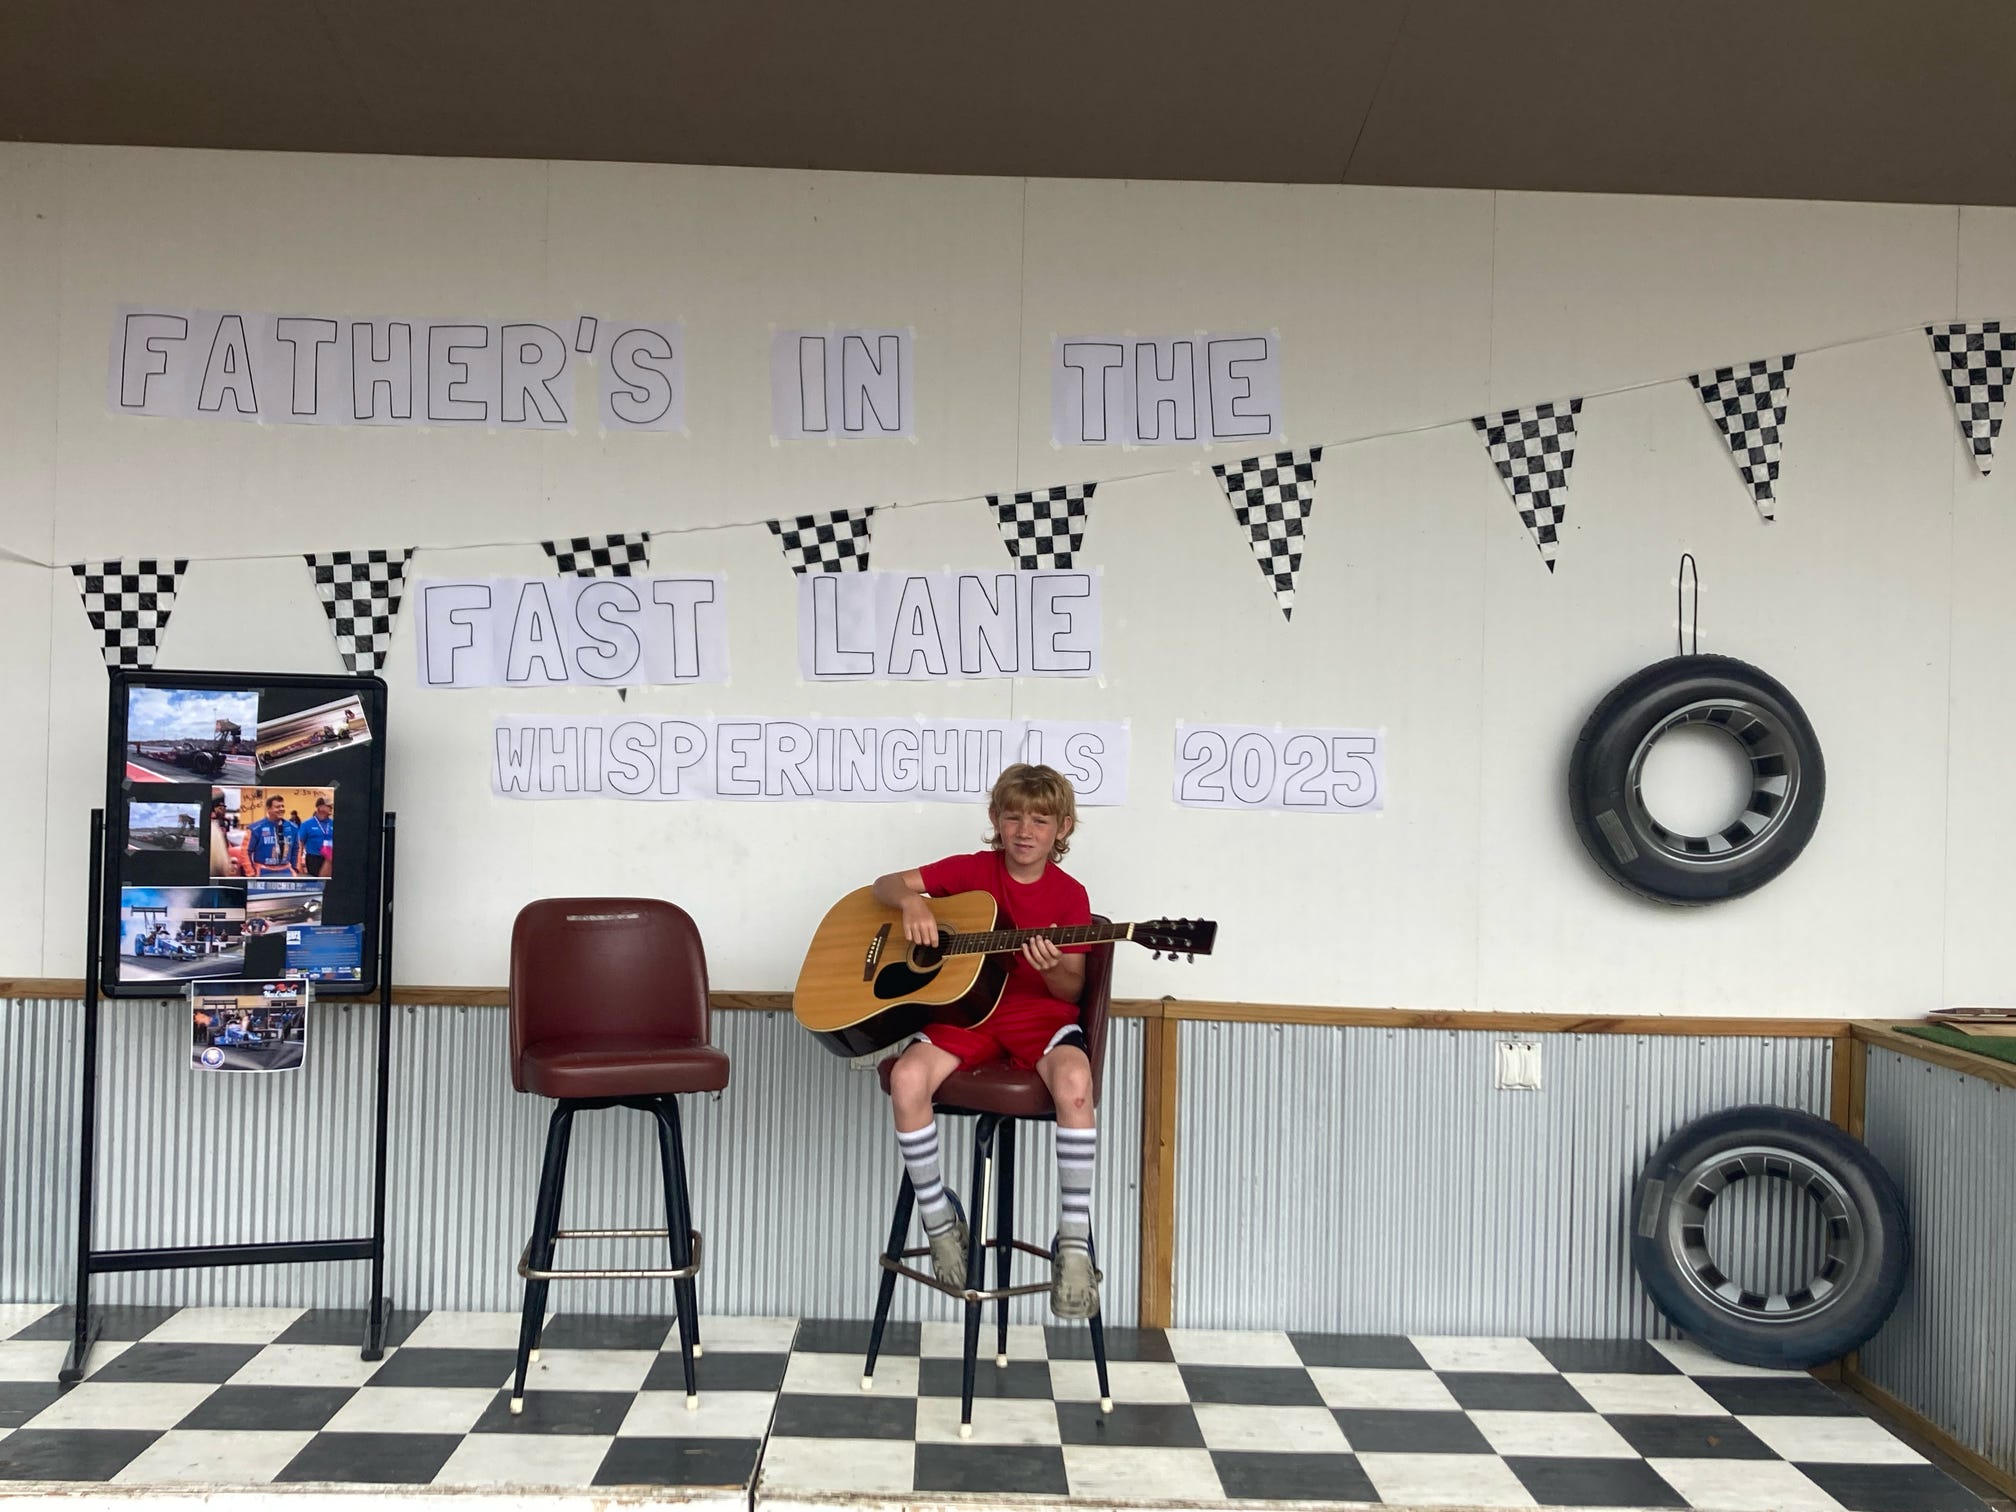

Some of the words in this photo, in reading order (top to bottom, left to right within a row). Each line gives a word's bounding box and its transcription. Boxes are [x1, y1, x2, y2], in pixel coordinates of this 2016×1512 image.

[120, 313, 674, 425] FATHER'S
[799, 334, 902, 433] IN
[1062, 337, 1272, 442] THE
[423, 579, 715, 685] FAST
[812, 574, 1092, 676] LANE
[1180, 730, 1378, 808] 2025
